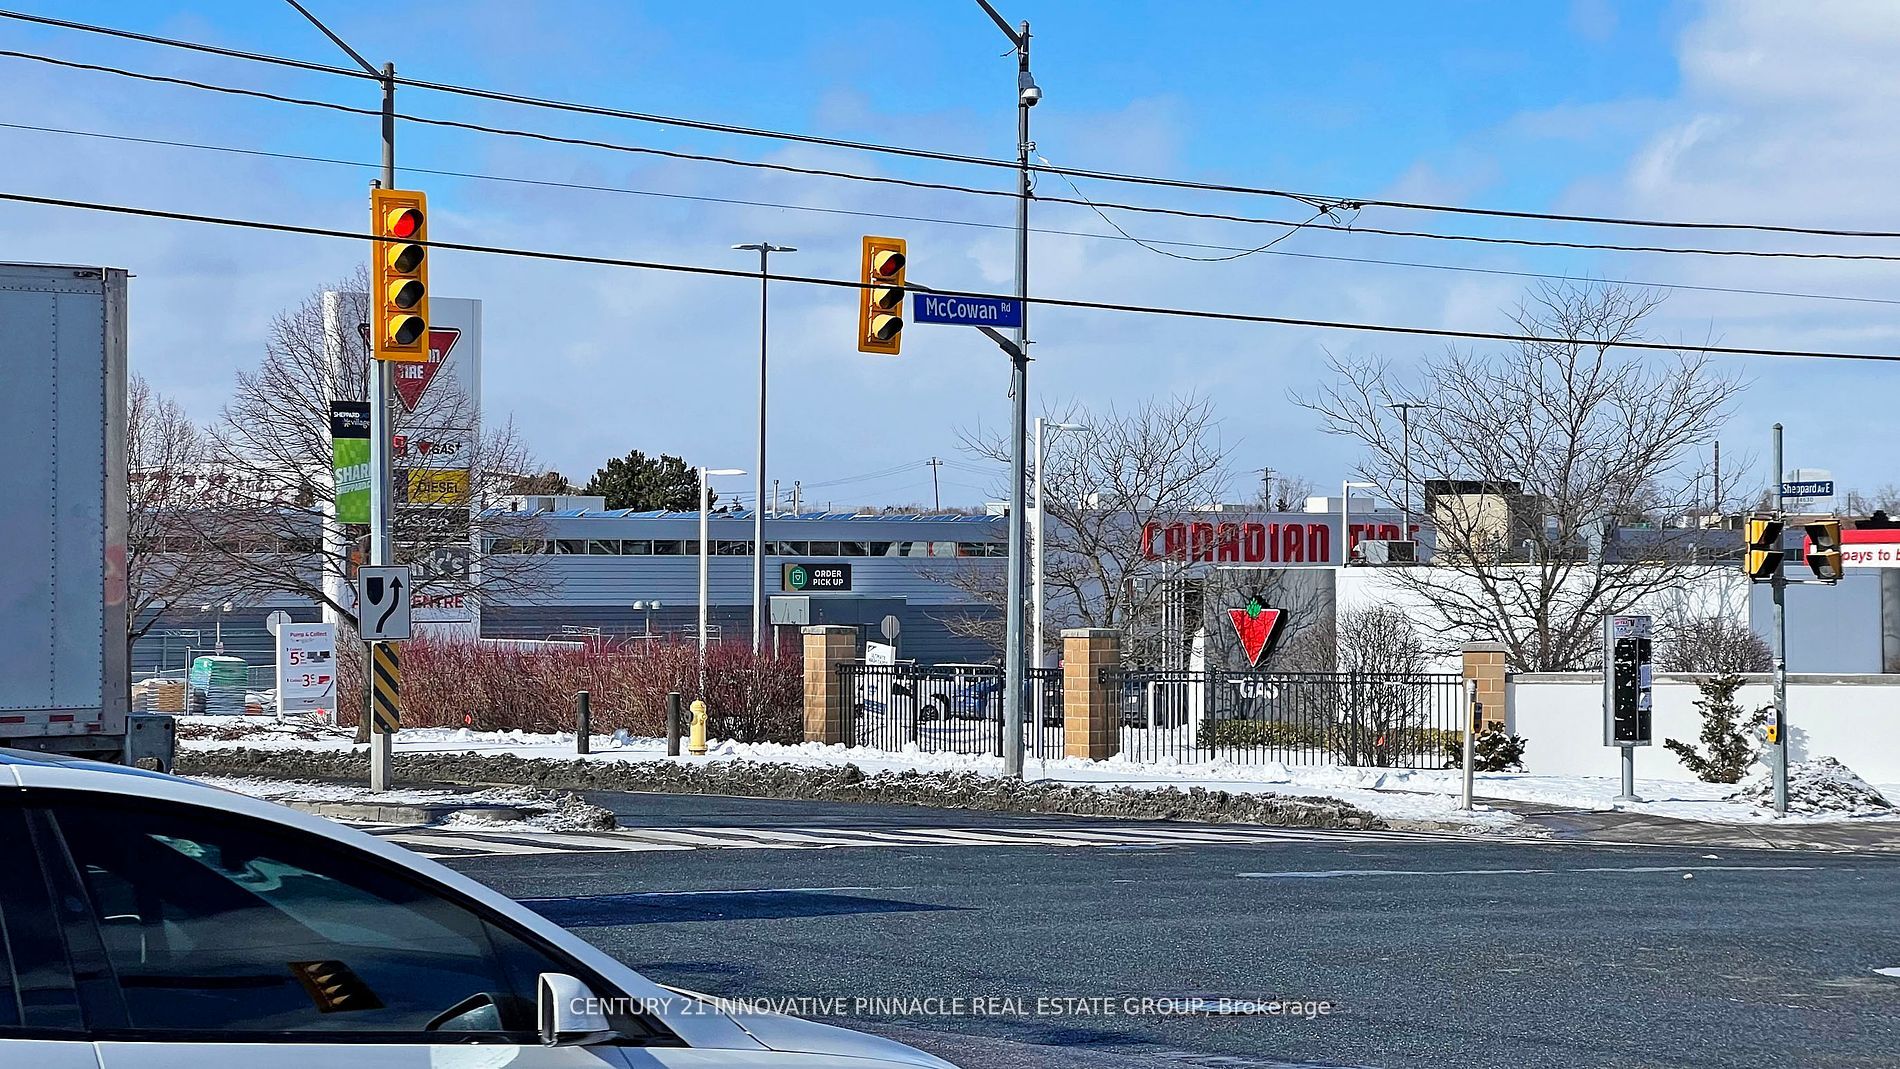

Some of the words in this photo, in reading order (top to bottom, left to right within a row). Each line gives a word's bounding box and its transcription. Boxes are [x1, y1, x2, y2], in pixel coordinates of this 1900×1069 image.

[926, 298, 998, 320] McCowan
[1001, 302, 1011, 313] Rd
[335, 462, 371, 483] SHAR
[419, 482, 461, 494] DIESEL
[1782, 483, 1817, 496] Sheppard
[1825, 482, 1831, 493] E
[1142, 521, 1330, 563] CANADIAN
[1878, 549, 1890, 561] to
[814, 570, 842, 578] ORDER
[813, 578, 831, 586] PICK
[833, 578, 844, 586] UP
[411, 594, 464, 609] ENTRE
